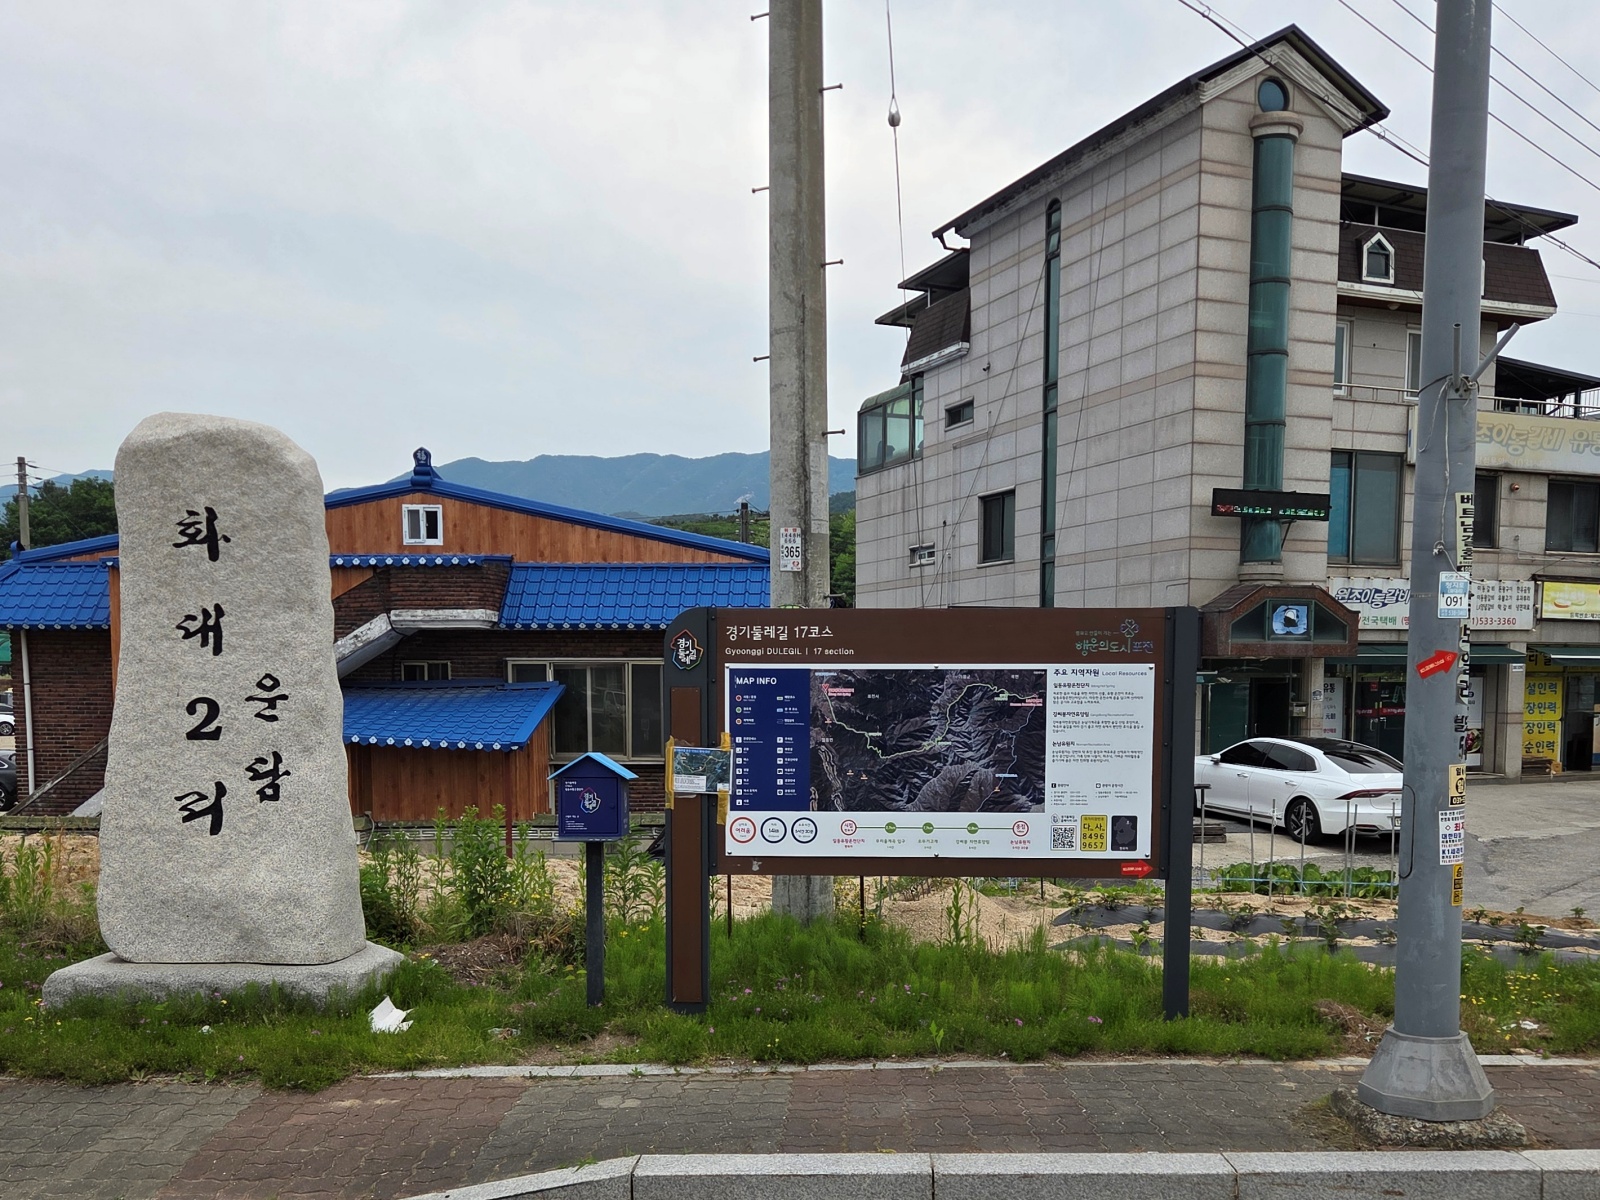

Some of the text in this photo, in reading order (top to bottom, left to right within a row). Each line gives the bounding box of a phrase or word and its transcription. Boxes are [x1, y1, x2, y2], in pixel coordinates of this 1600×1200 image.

[784, 545, 800, 558] 365
[1445, 596, 1463, 607] 091
[1361, 616, 1397, 626] 전국택배
[726, 625, 834, 641] 경기둘레길 17코스
[767, 647, 802, 655] DULEGIL
[813, 647, 822, 655] 17
[824, 647, 855, 655] section
[1053, 668, 1068, 677] 주요
[1070, 668, 1100, 677] 지역자원
[736, 677, 777, 685] MAP INFO
[1526, 683, 1558, 695] 설인력
[1525, 702, 1556, 715] 장인력
[1524, 722, 1556, 734] 장인력
[1524, 741, 1555, 753] 순인력
